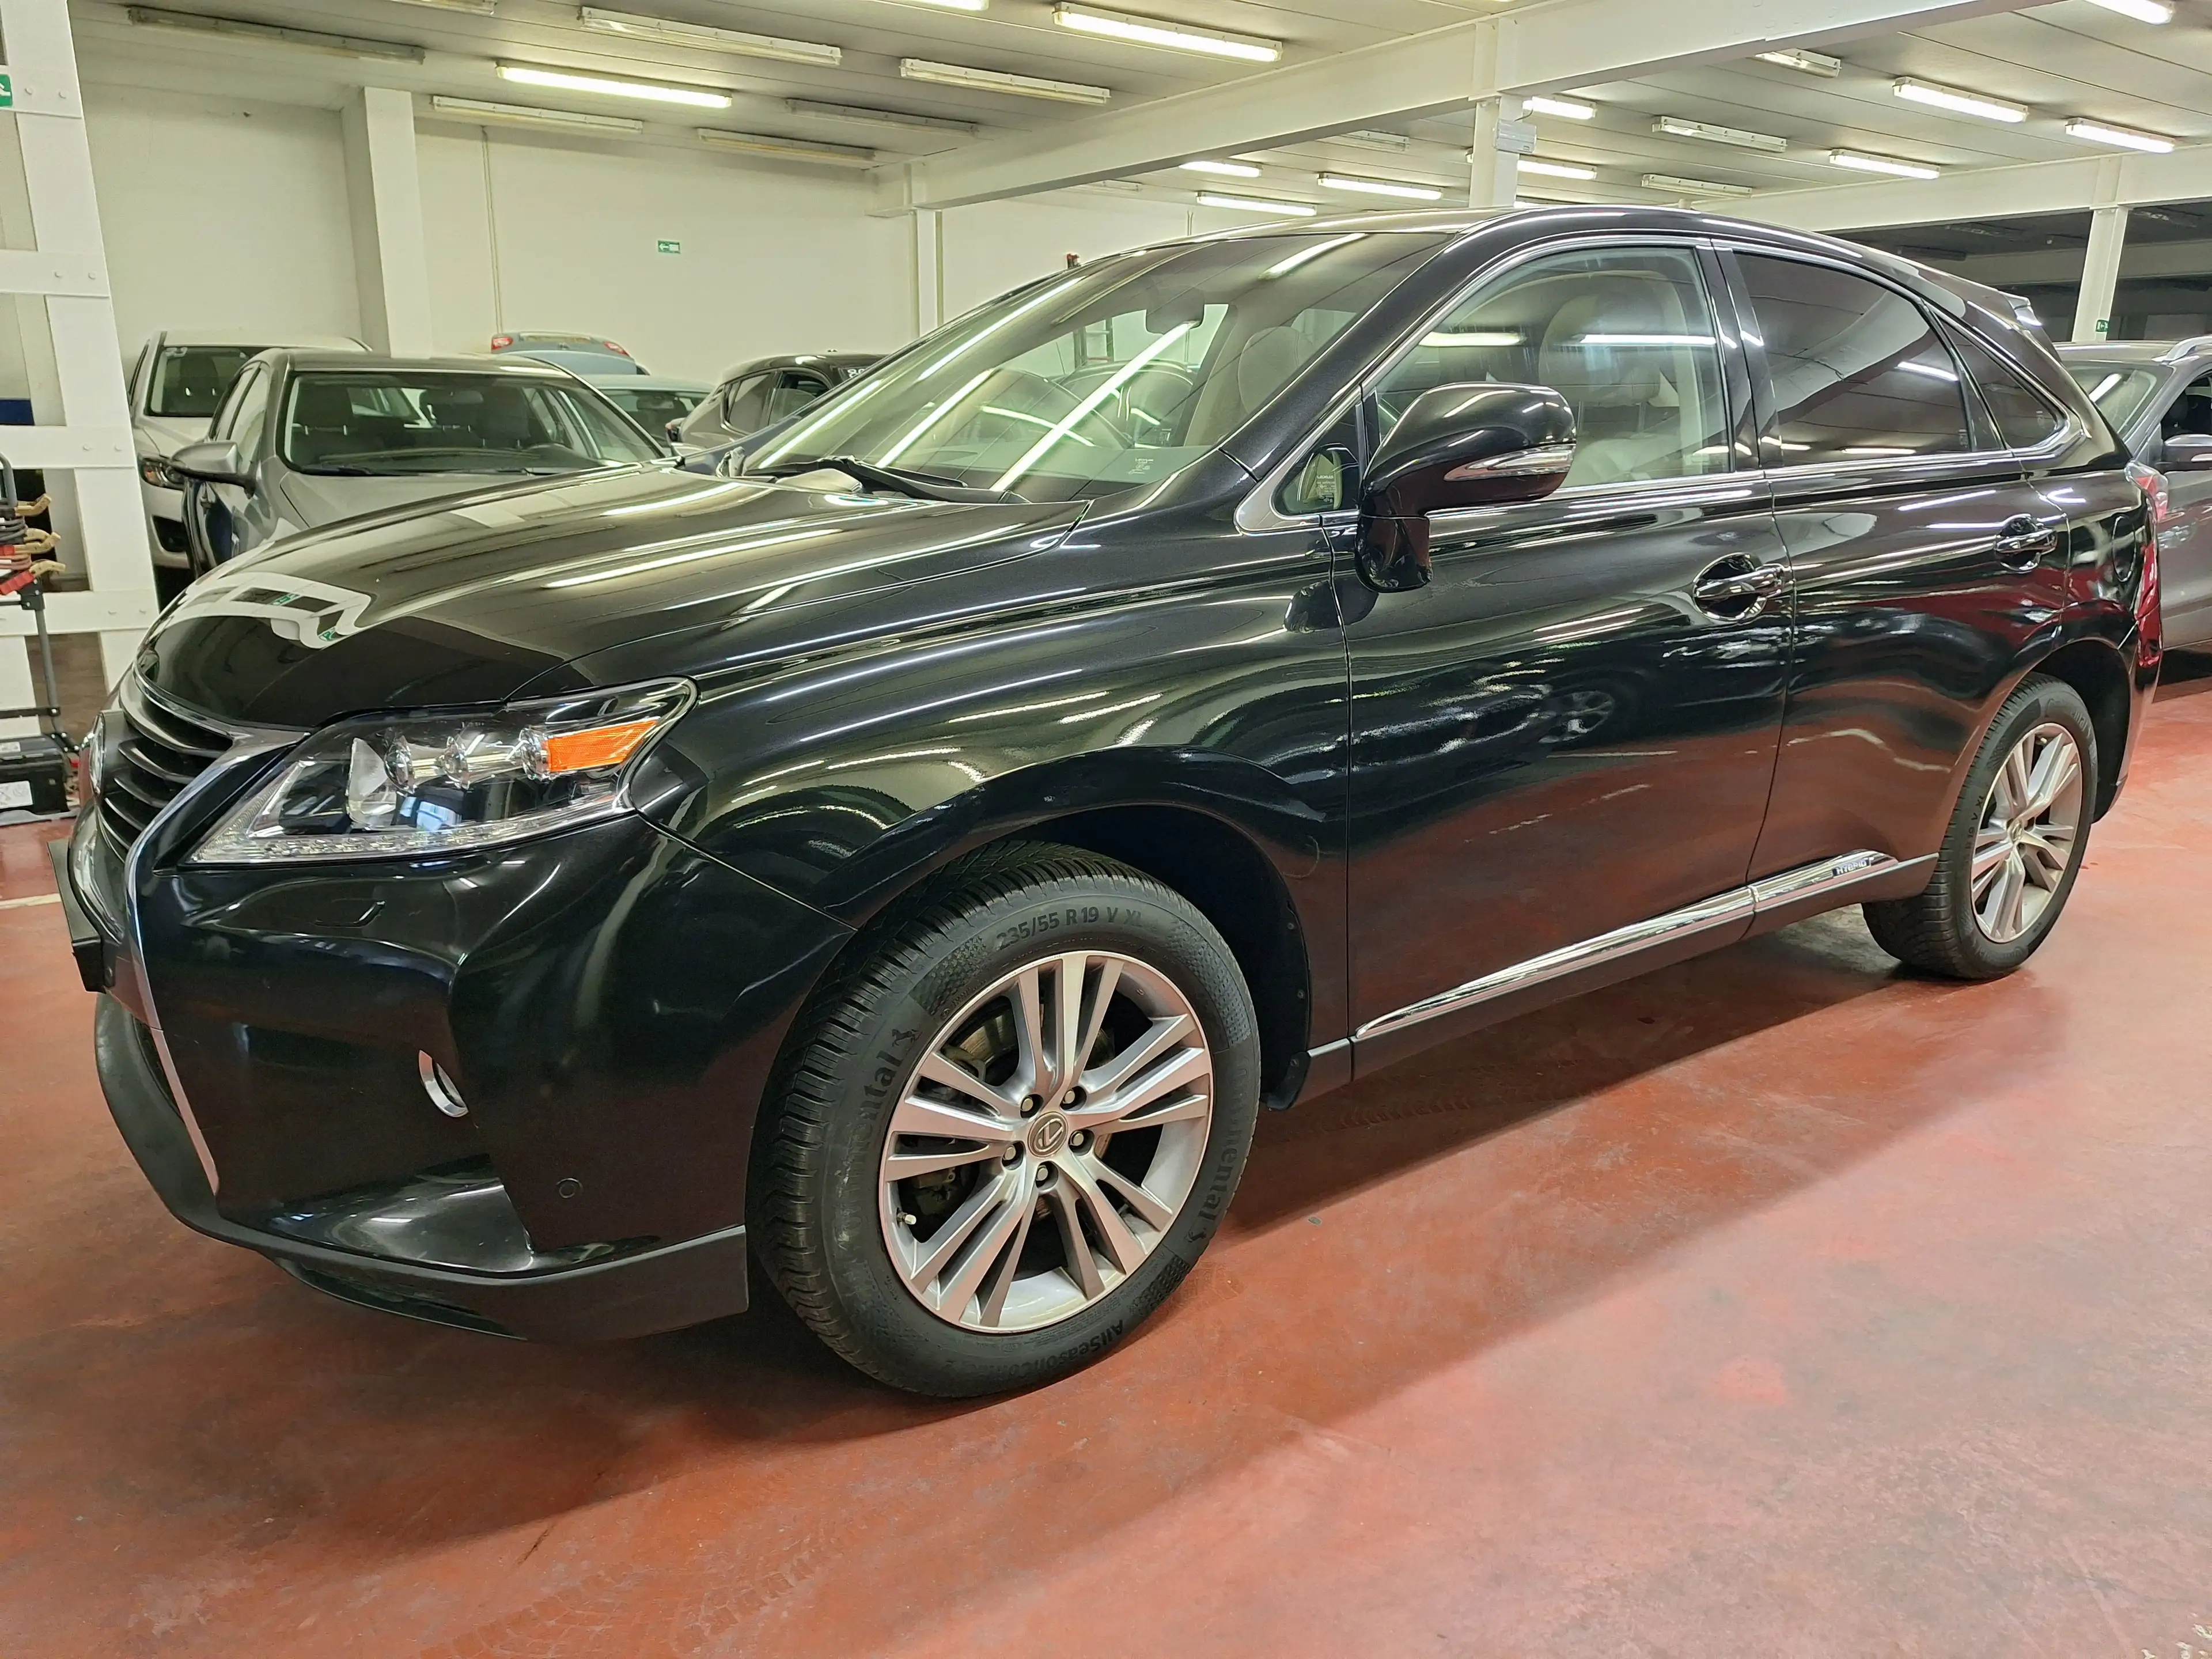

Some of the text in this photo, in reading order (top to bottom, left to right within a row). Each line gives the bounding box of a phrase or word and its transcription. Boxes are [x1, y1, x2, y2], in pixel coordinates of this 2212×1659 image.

[1836, 860, 1868, 875] HYBRID
[996, 912, 1060, 950] 235/55
[1065, 908, 1077, 926] R
[1081, 907, 1099, 923] 19
[1107, 907, 1118, 923] V
[1123, 908, 1142, 925] XL
